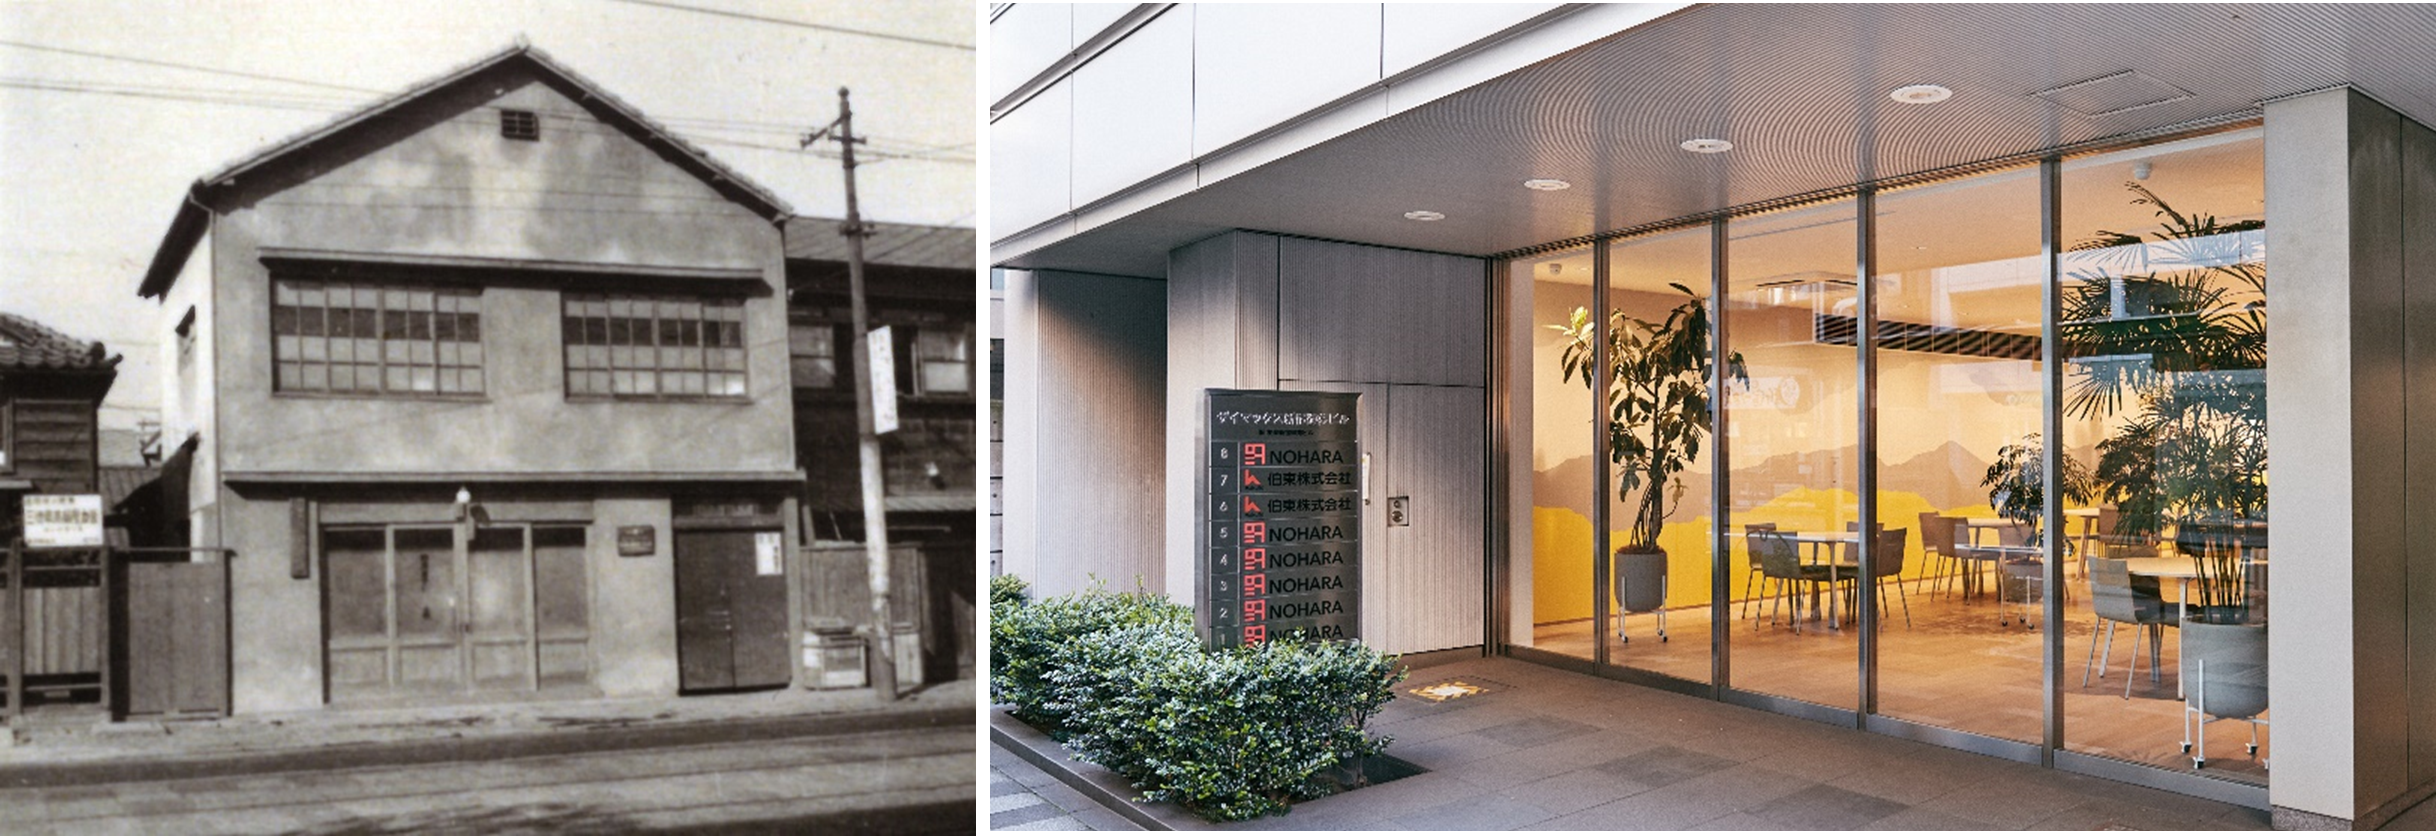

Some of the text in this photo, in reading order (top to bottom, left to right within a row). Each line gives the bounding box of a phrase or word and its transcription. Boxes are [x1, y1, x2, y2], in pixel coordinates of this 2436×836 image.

[1220, 447, 1344, 464] 8 NOHARA
[1220, 472, 1352, 487] 7 伯東株式会社
[1219, 498, 1352, 514] 6 伯東株式会社
[1219, 525, 1344, 542] 5 NOHARA
[1219, 551, 1344, 569] 4 NOHARA
[1220, 575, 1344, 595] 3 NOHARA
[1219, 600, 1344, 620] 2 NOHARA
